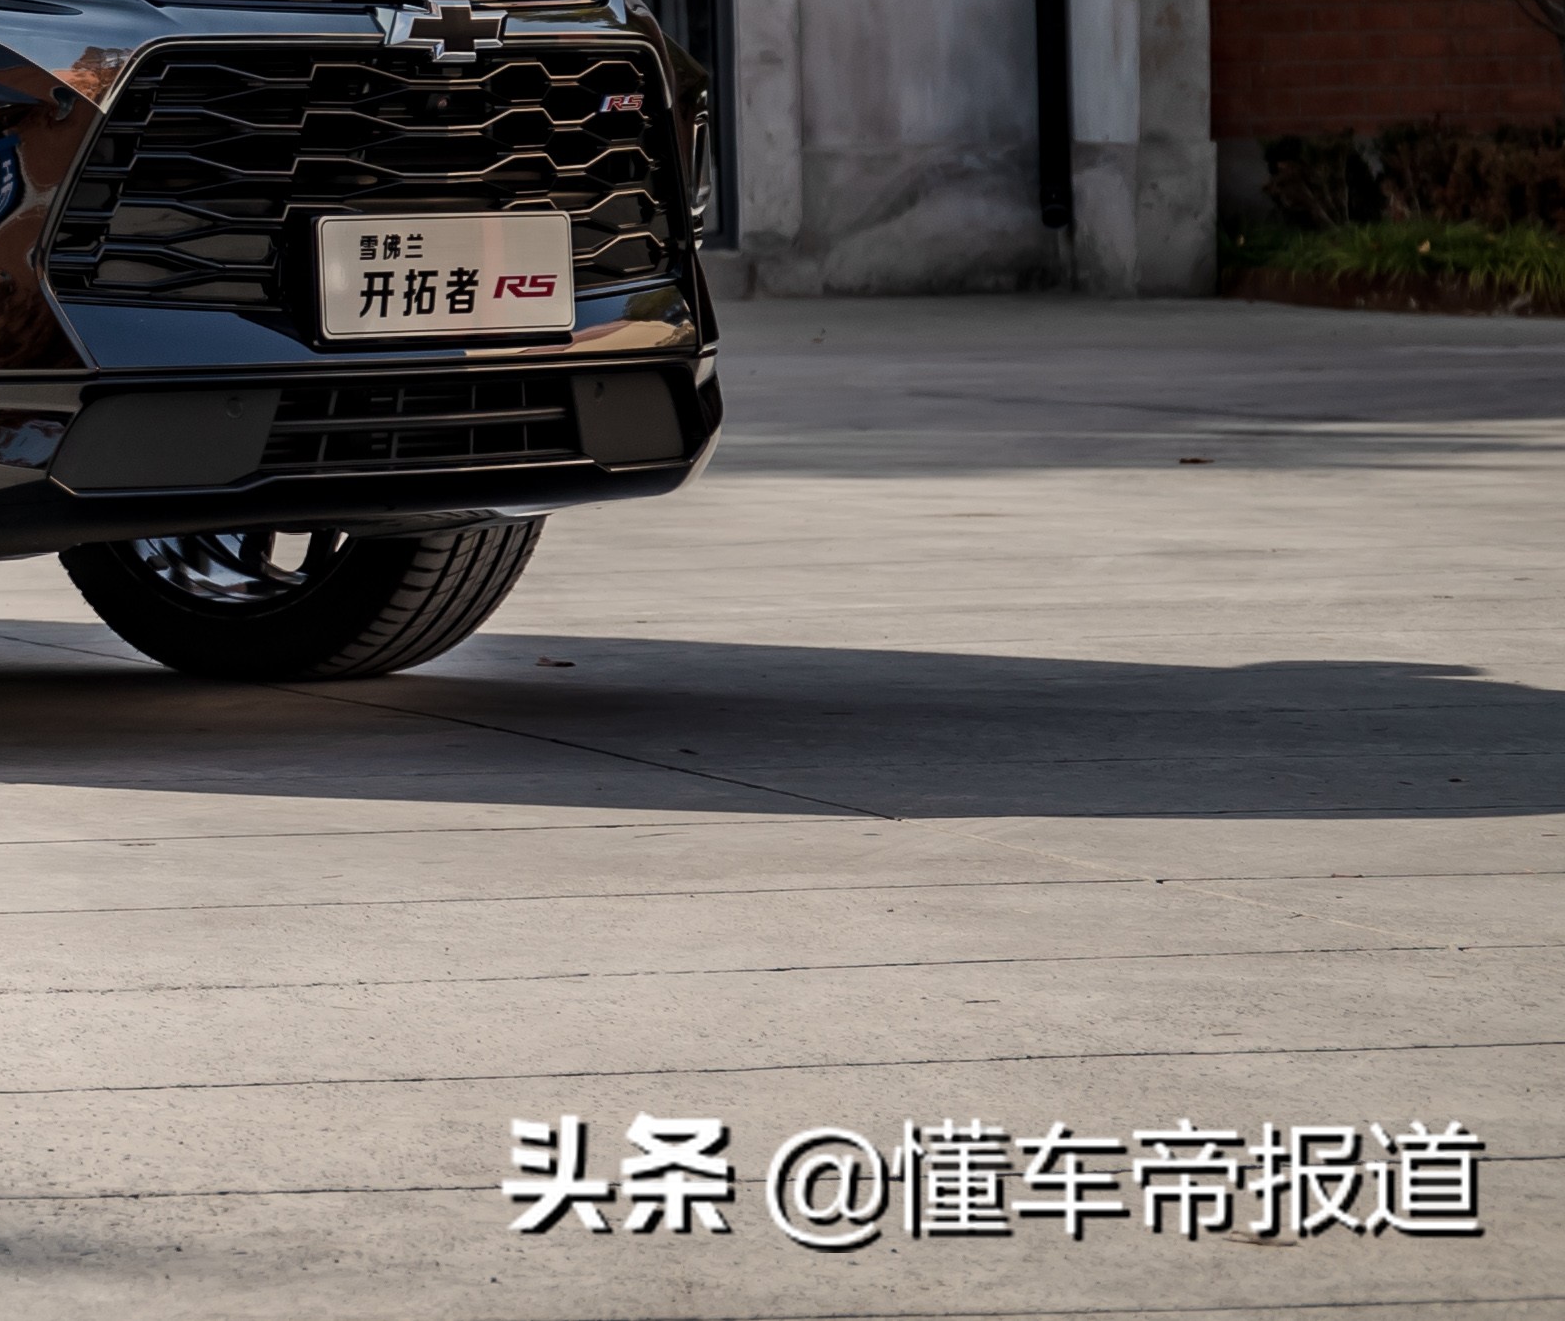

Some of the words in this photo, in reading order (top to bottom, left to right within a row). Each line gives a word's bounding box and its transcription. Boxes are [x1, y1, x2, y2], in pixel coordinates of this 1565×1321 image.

[600, 94, 644, 112] RS
[359, 233, 424, 261] 雪佛兰
[359, 267, 480, 319] 开拓者
[493, 274, 558, 299] RS
